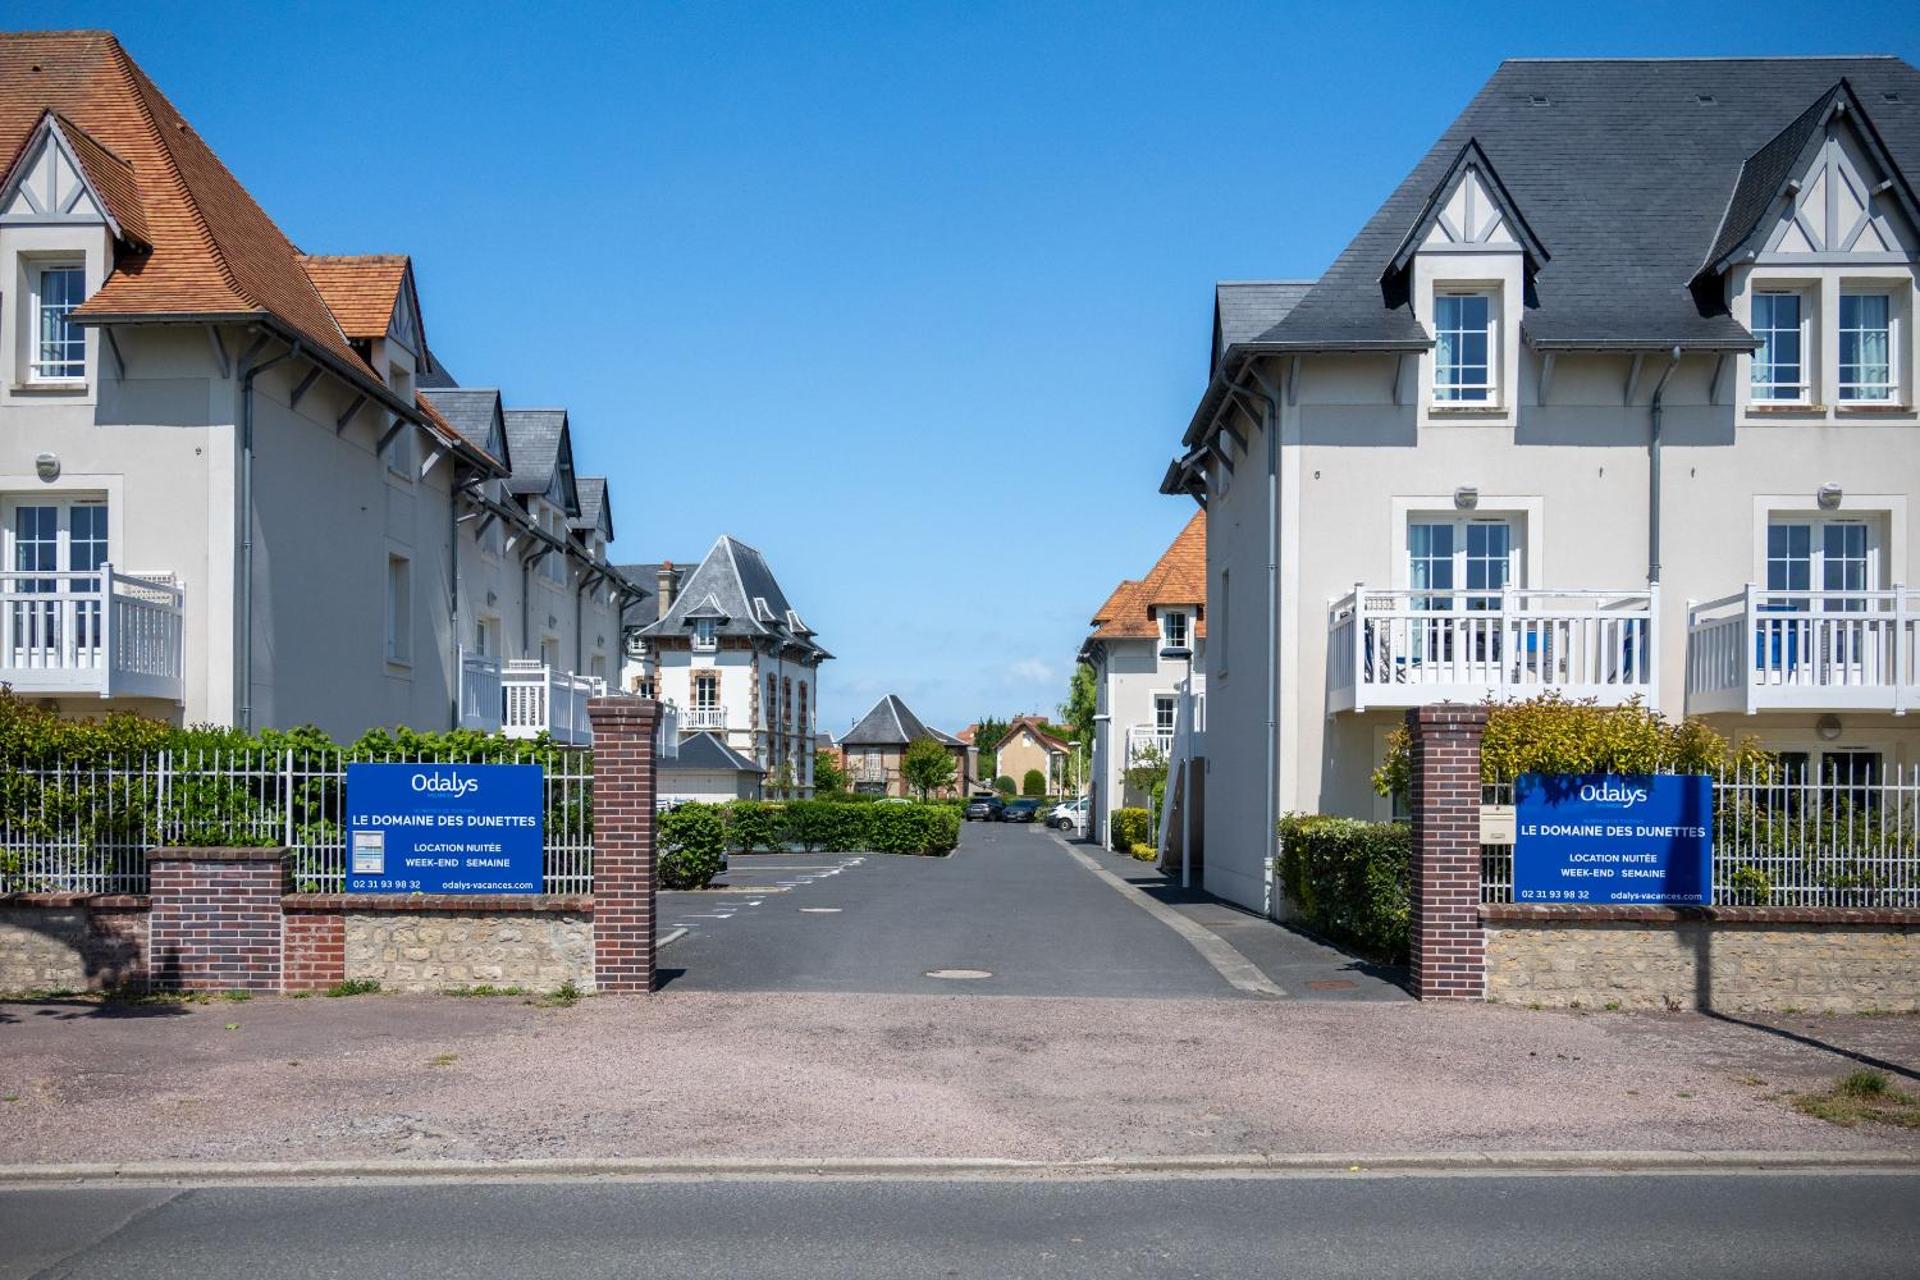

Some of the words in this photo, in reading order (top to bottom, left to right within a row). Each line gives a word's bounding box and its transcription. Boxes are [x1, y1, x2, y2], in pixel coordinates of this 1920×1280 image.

[411, 771, 478, 798] Odalys
[1580, 781, 1648, 808] Odalys
[352, 815, 369, 826] LE
[371, 815, 434, 826] DOMAINE
[437, 815, 464, 827] DES
[467, 816, 536, 827] DUNETTES
[1521, 825, 1537, 836] LE
[1540, 825, 1603, 837] DOMAINE
[1606, 825, 1633, 837] DES
[1636, 826, 1706, 838] DUNETTES
[414, 843, 464, 853] LOCATION
[466, 841, 502, 853] NUITÉE
[405, 858, 459, 868] WEEK-END
[466, 858, 511, 868] SEMAINE
[1569, 853, 1620, 863] LOCATION
[1622, 852, 1657, 863] NUITÉE
[1560, 868, 1615, 878] WEEK-END
[1621, 868, 1666, 878] SEMAINE
[352, 880, 366, 889] 02
[367, 880, 378, 889] 31
[380, 880, 393, 889] 93
[395, 880, 407, 889] 98
[409, 880, 421, 889] 32
[442, 880, 534, 891] odalys-vacances.com
[1521, 890, 1534, 899] 02
[1536, 890, 1547, 899] 31
[1549, 890, 1561, 899] 93
[1563, 890, 1576, 899] 98
[1577, 890, 1590, 899] 32
[1610, 891, 1703, 902] odalys-vacances.com
